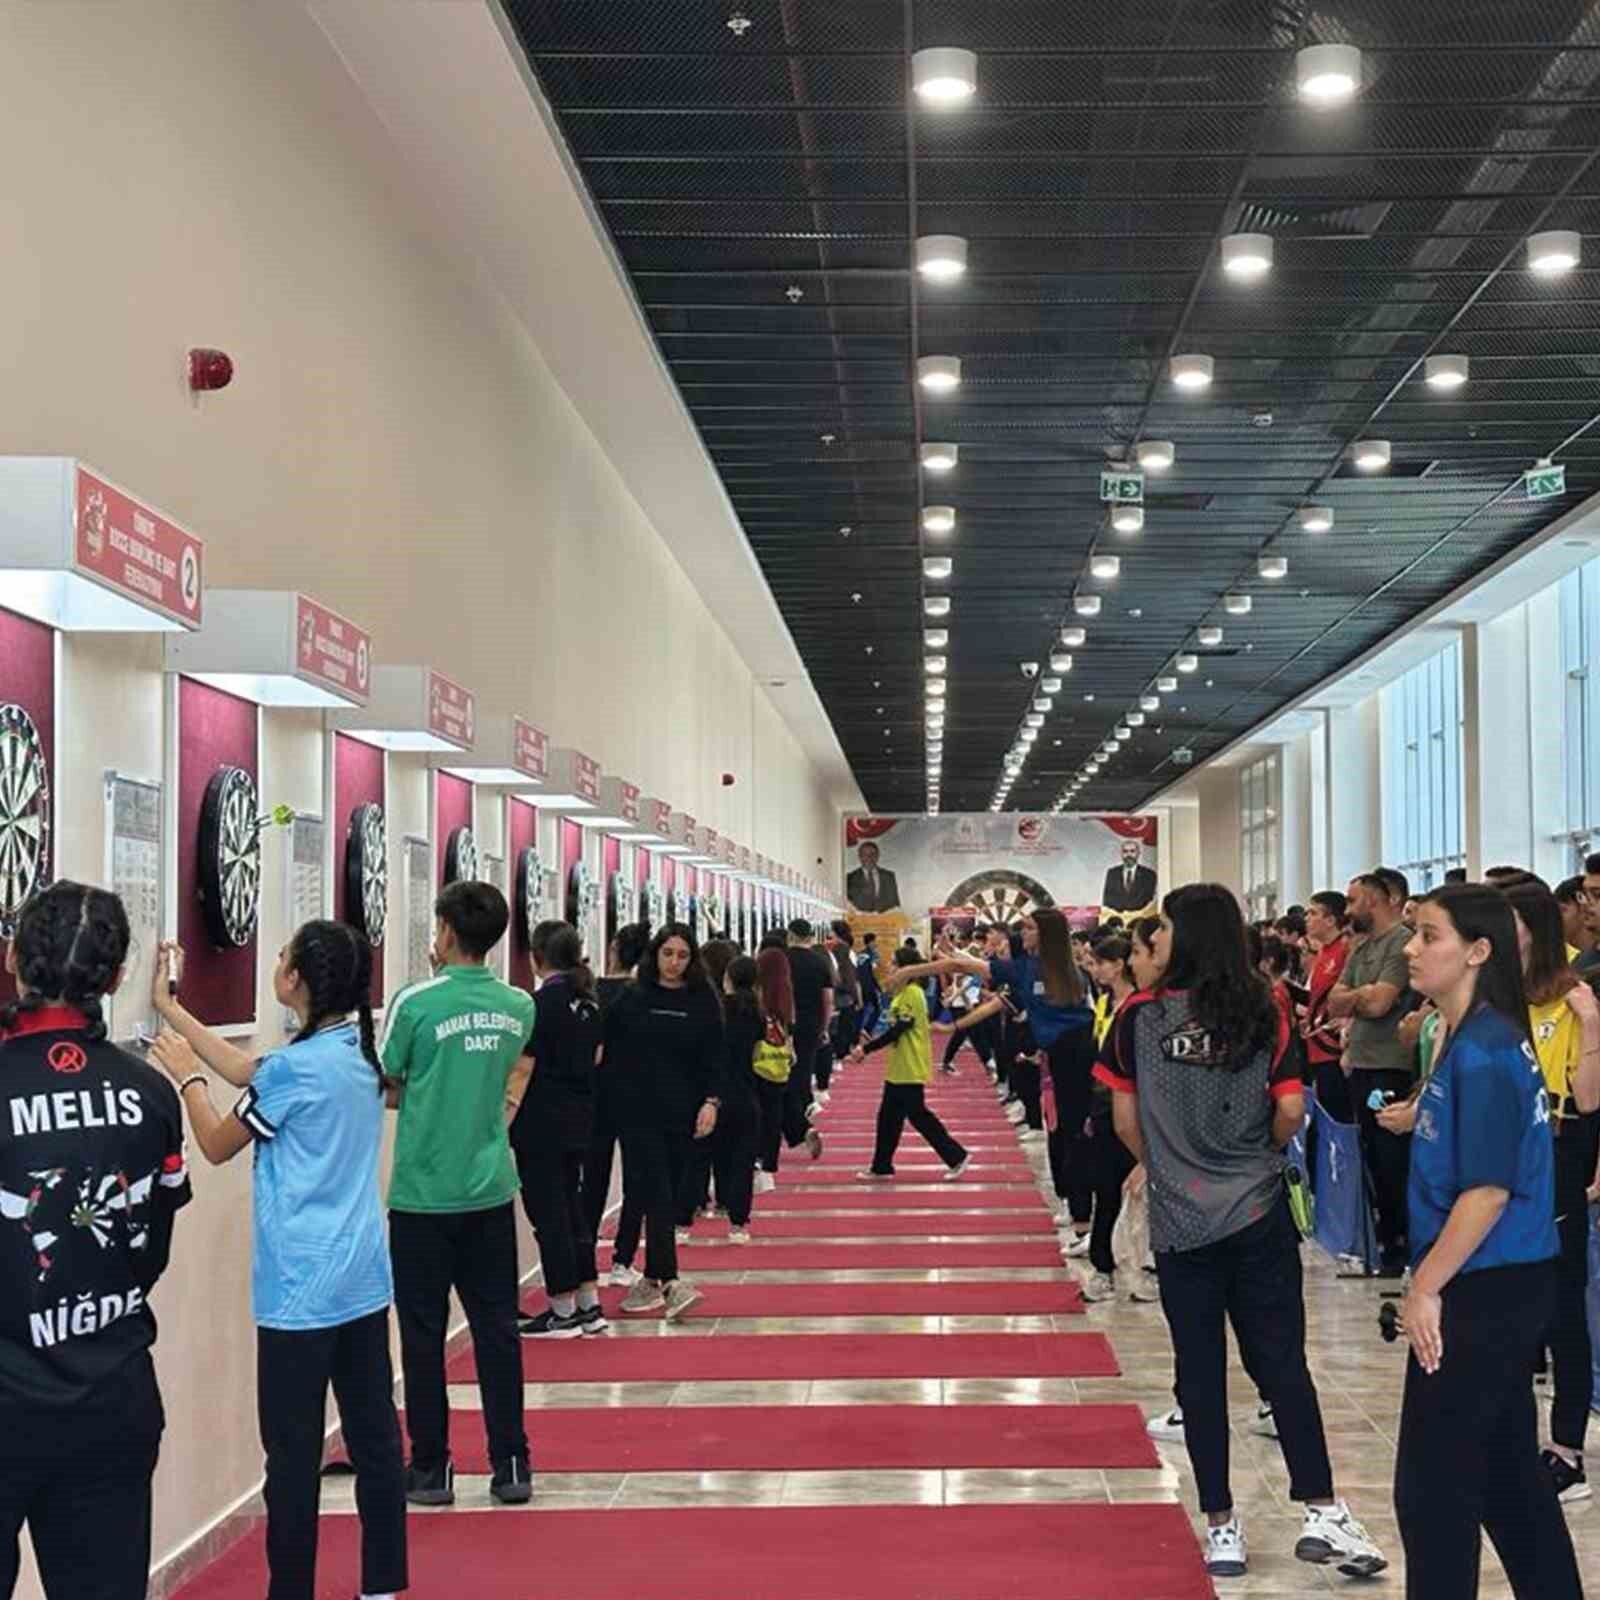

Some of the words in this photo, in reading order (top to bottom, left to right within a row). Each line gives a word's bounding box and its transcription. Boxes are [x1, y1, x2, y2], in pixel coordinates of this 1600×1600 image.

[184, 556, 194, 598] 2
[464, 1034, 500, 1051] DART
[9, 1081, 143, 1136] MELİS
[29, 1287, 144, 1349] NİĞDE
